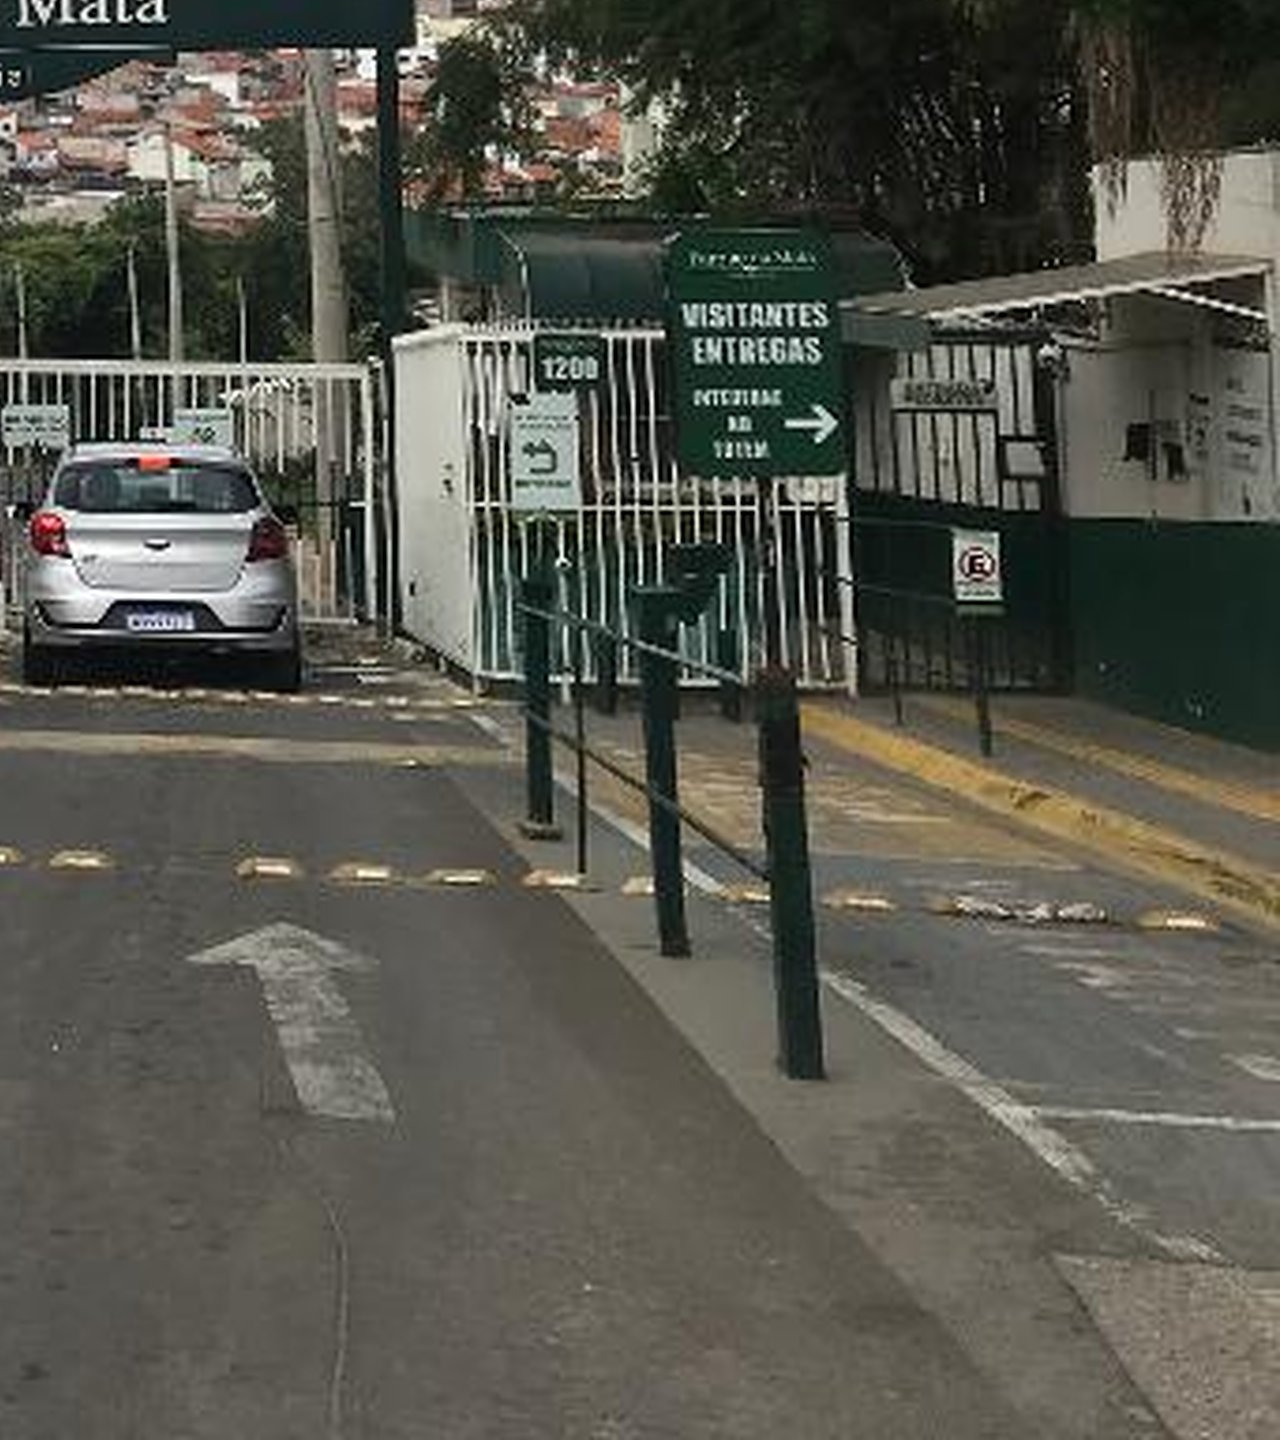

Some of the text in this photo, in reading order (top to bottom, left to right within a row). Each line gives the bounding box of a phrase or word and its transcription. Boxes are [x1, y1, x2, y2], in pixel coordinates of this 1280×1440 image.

[681, 302, 830, 329] VISITANTES
[692, 335, 824, 366] ENTREGAS
[541, 355, 599, 380] 1200
